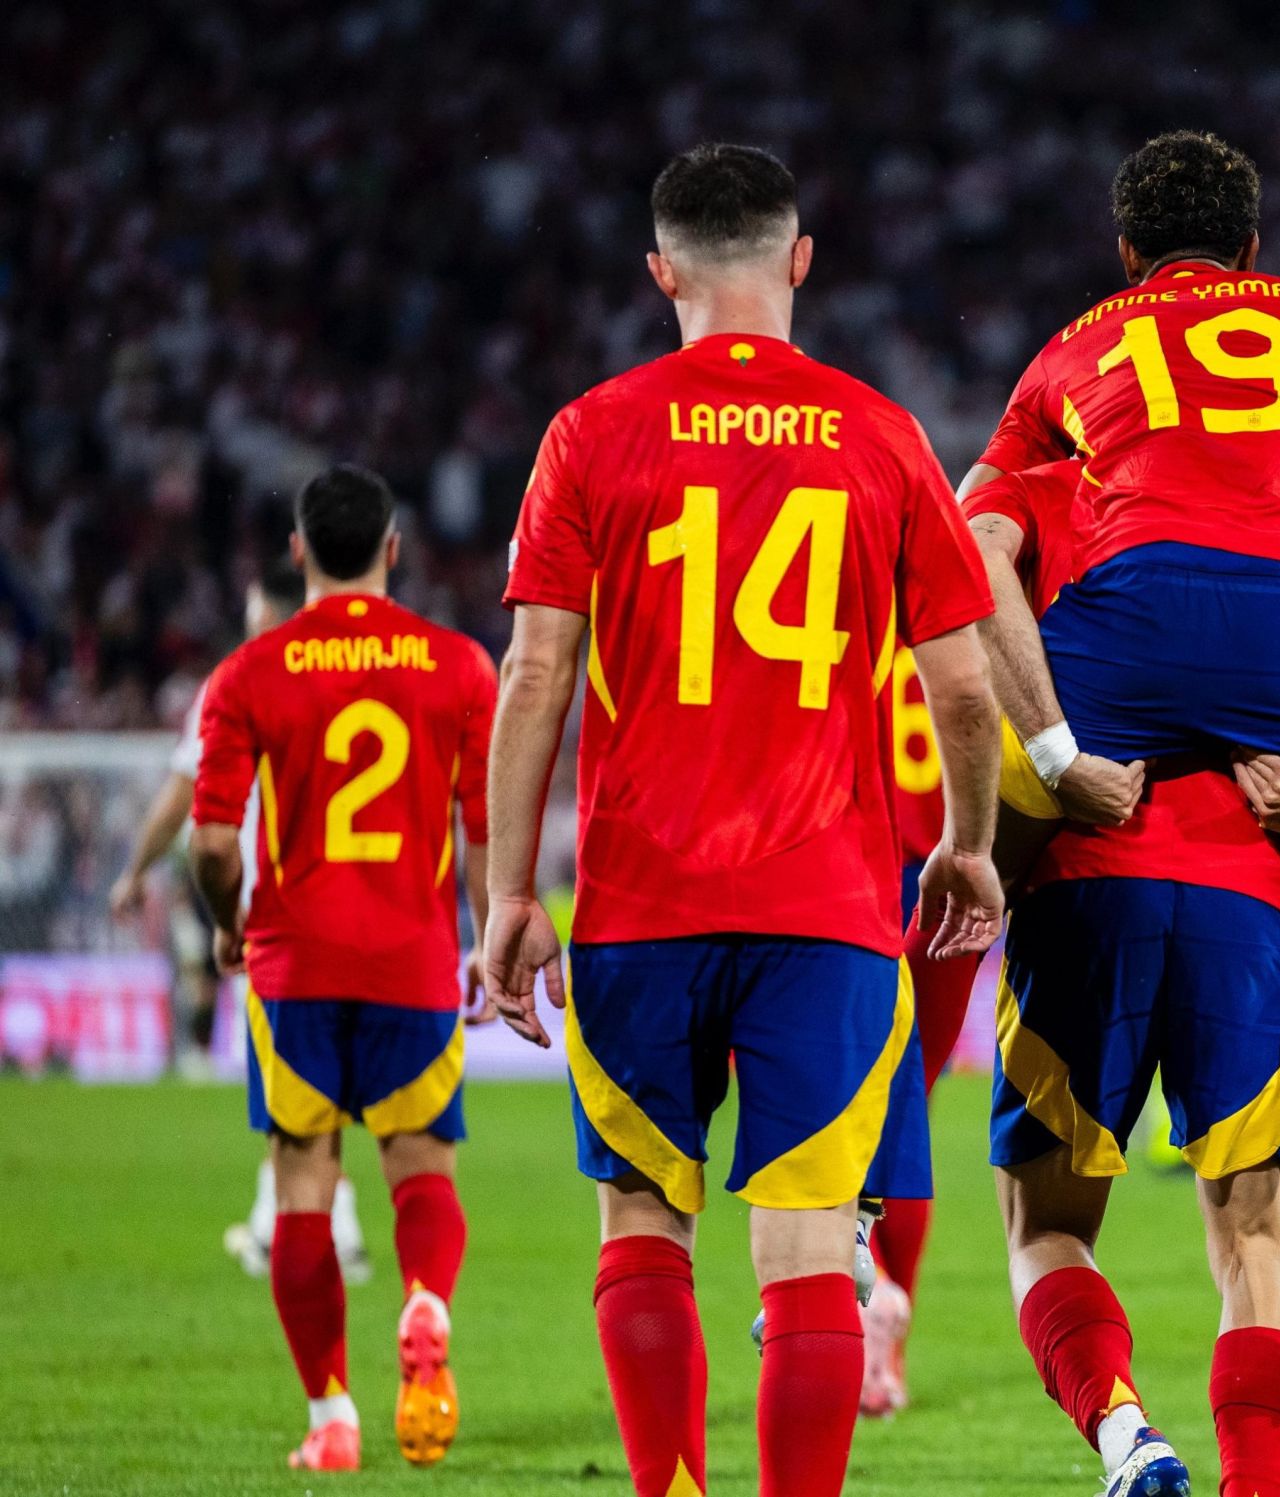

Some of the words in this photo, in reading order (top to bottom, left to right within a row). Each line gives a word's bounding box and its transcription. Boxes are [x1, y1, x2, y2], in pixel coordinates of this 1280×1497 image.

[1061, 289, 1178, 344] LAMINE
[669, 402, 843, 450] LAPORTE
[647, 485, 851, 711] 14
[284, 634, 437, 674] CARVAJAL
[323, 698, 410, 862] 2
